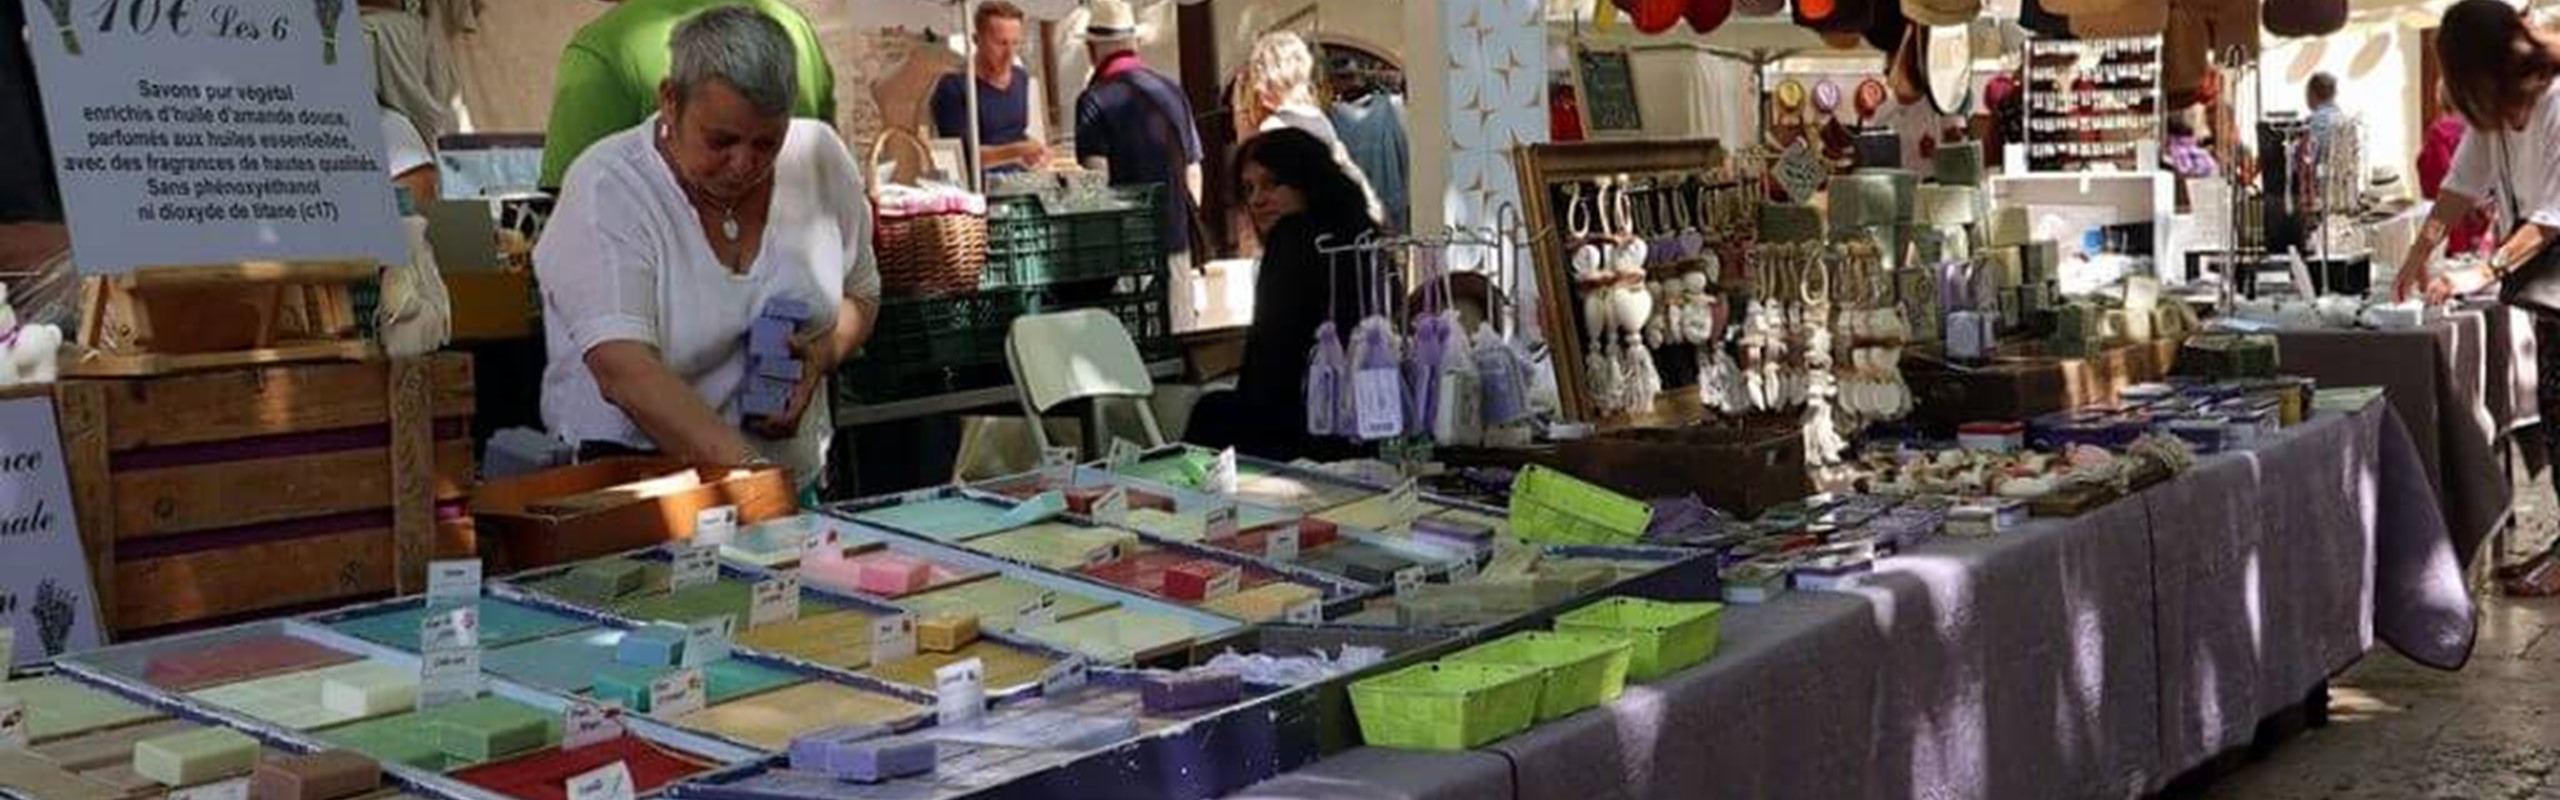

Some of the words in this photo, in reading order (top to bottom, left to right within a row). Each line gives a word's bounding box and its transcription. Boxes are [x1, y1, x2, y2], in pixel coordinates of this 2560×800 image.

[91, 0, 193, 36] 10€
[207, 3, 260, 40] Les
[271, 16, 290, 41] 6
[138, 78, 200, 99] Savons
[204, 84, 233, 101] pur
[238, 82, 295, 104] végétal
[83, 105, 153, 123] enrichis
[157, 105, 215, 124] d'huile
[218, 106, 295, 125] d'amande
[299, 109, 350, 128] douce,
[87, 129, 169, 149] parfumés
[173, 133, 203, 147] aux
[206, 130, 256, 149] huiles
[260, 132, 356, 151] essentielles,
[64, 155, 106, 171] avec
[110, 154, 143, 171] des
[146, 153, 235, 175] fragrances
[239, 154, 259, 171] de
[262, 154, 316, 172] hautes
[319, 153, 381, 176] qualités.
[147, 178, 190, 197] Sans
[194, 178, 322, 199] phénoxyéthanol
[138, 204, 156, 221] ni
[159, 203, 226, 223] dioxyde
[229, 203, 249, 220] de
[252, 203, 297, 220] titane
[301, 201, 340, 223] (c17)
